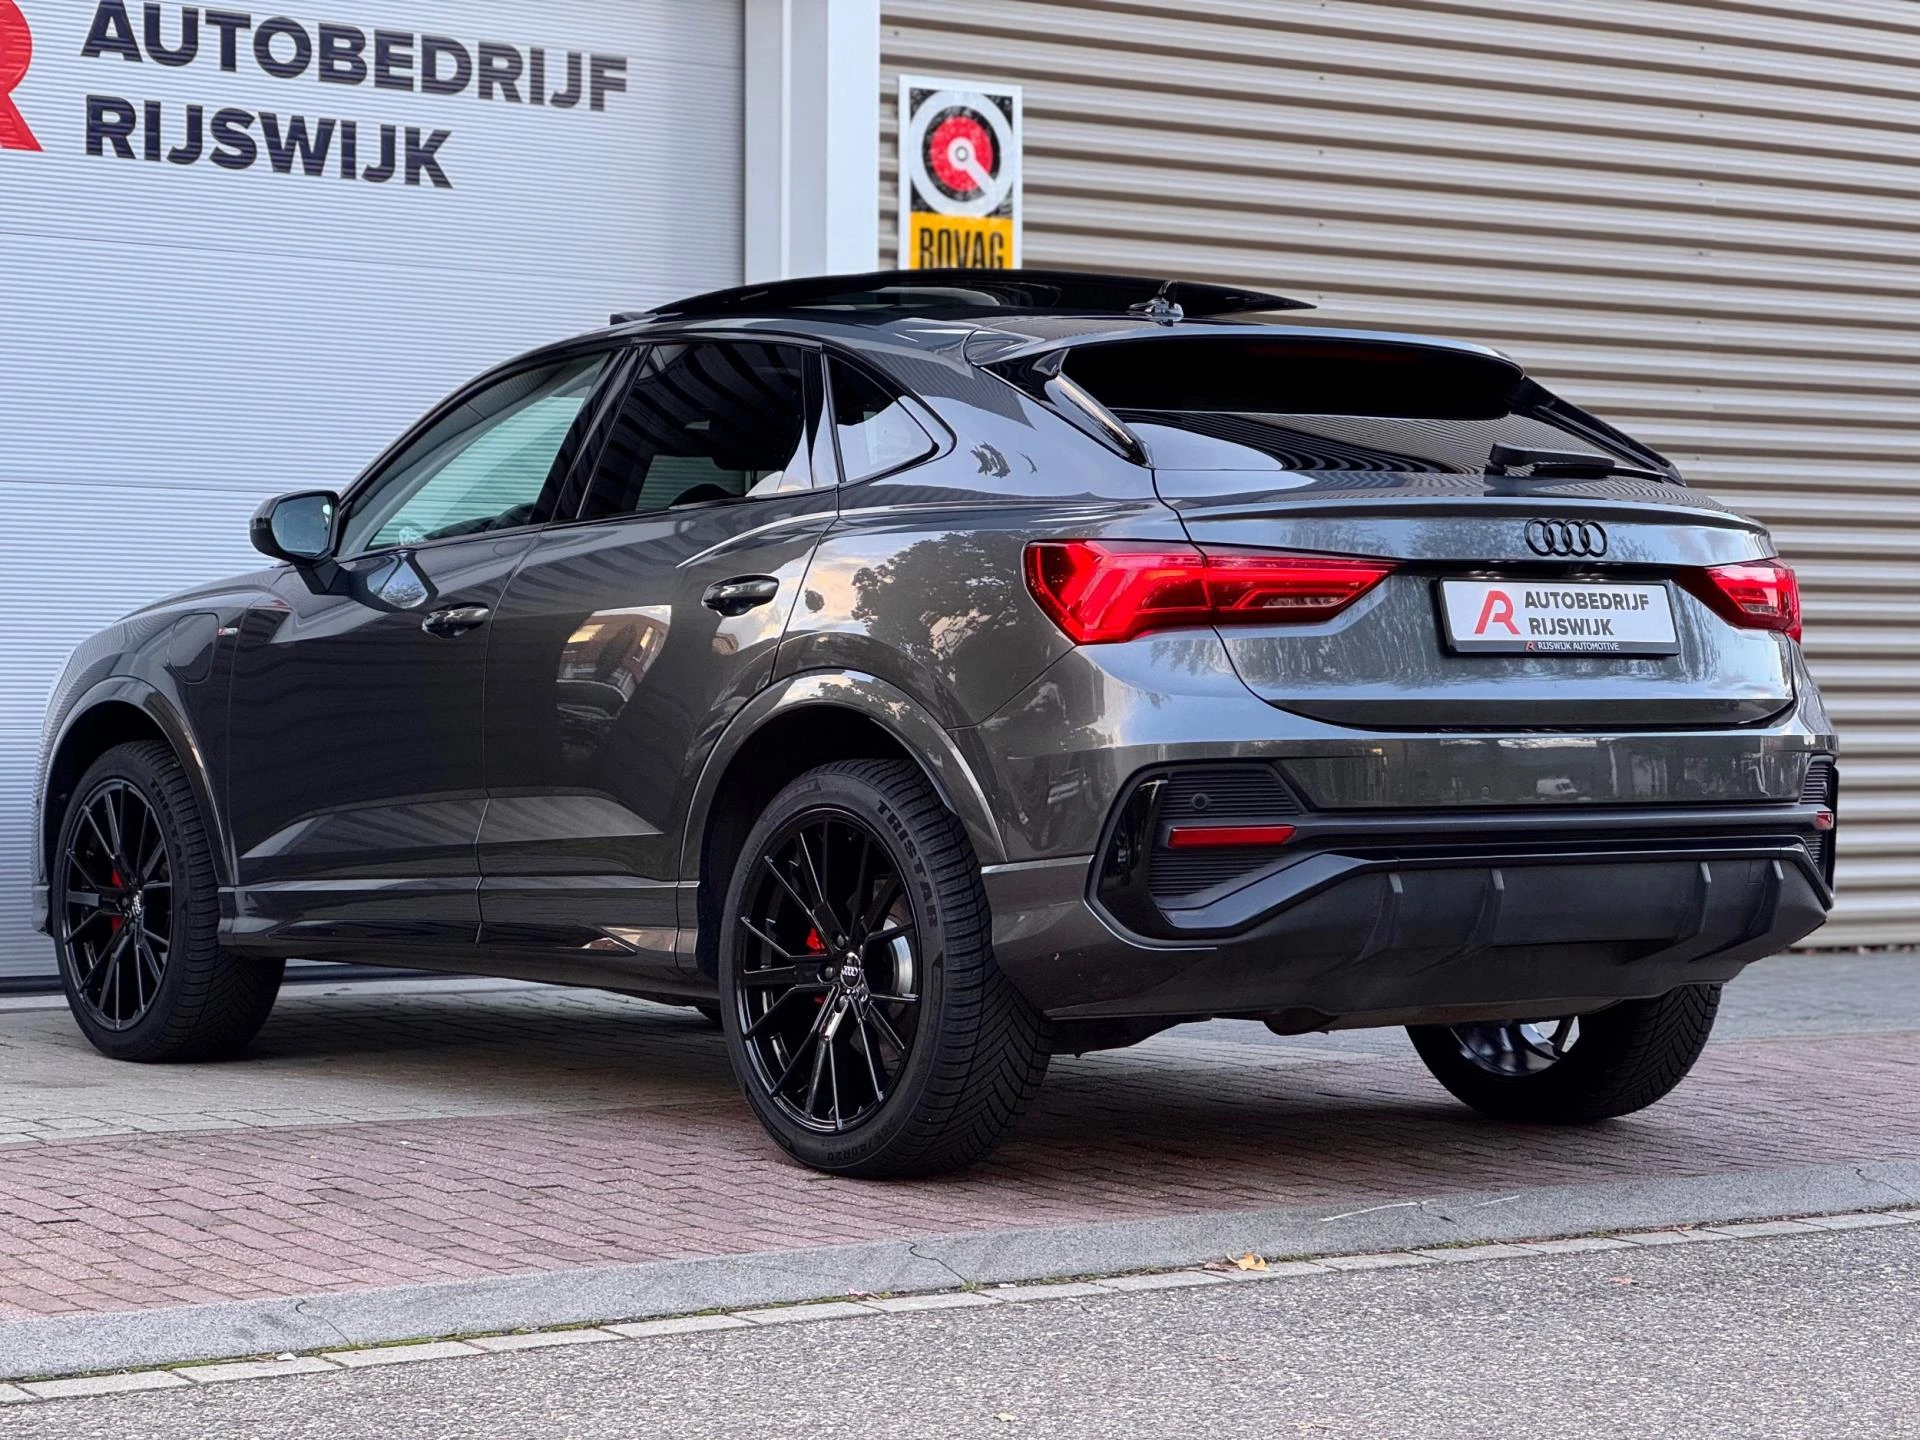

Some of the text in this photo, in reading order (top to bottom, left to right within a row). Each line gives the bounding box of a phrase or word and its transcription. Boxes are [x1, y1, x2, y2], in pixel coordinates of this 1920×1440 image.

[80, 0, 628, 112] AUTOBEDRIJF
[85, 94, 453, 189] RIJSWIJK
[919, 227, 1004, 269] BOVAG
[1524, 591, 1649, 611] AUTOBEDRIJF
[1528, 617, 1615, 636] RIJSWIJK
[1537, 641, 1571, 651] RIJSWIJK
[1573, 642, 1620, 651] AUTOMOTIVE
[877, 799, 938, 928] TRISTAR
